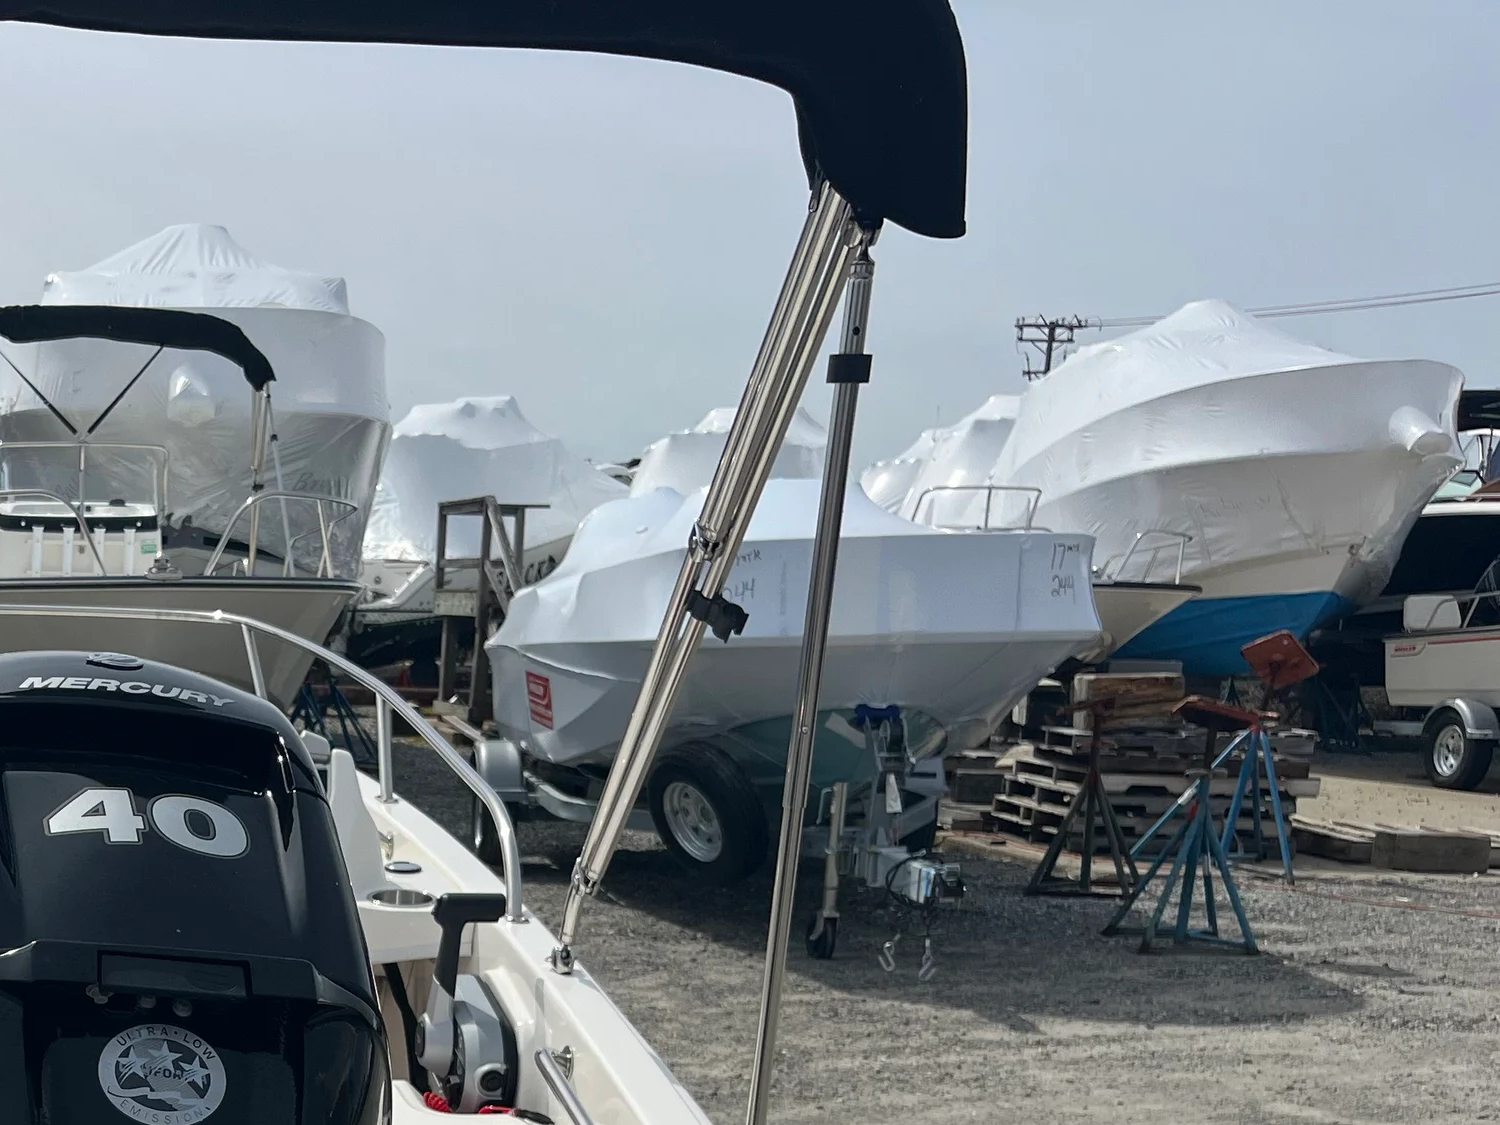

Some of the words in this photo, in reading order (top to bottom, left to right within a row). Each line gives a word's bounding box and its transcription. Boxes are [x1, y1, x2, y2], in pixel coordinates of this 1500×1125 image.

[18, 676, 235, 707] MERCURY
[43, 786, 251, 859] 40
[115, 1026, 169, 1047] ULTRA
[182, 1033, 216, 1060] LOW
[119, 1099, 204, 1125] EMISSION
